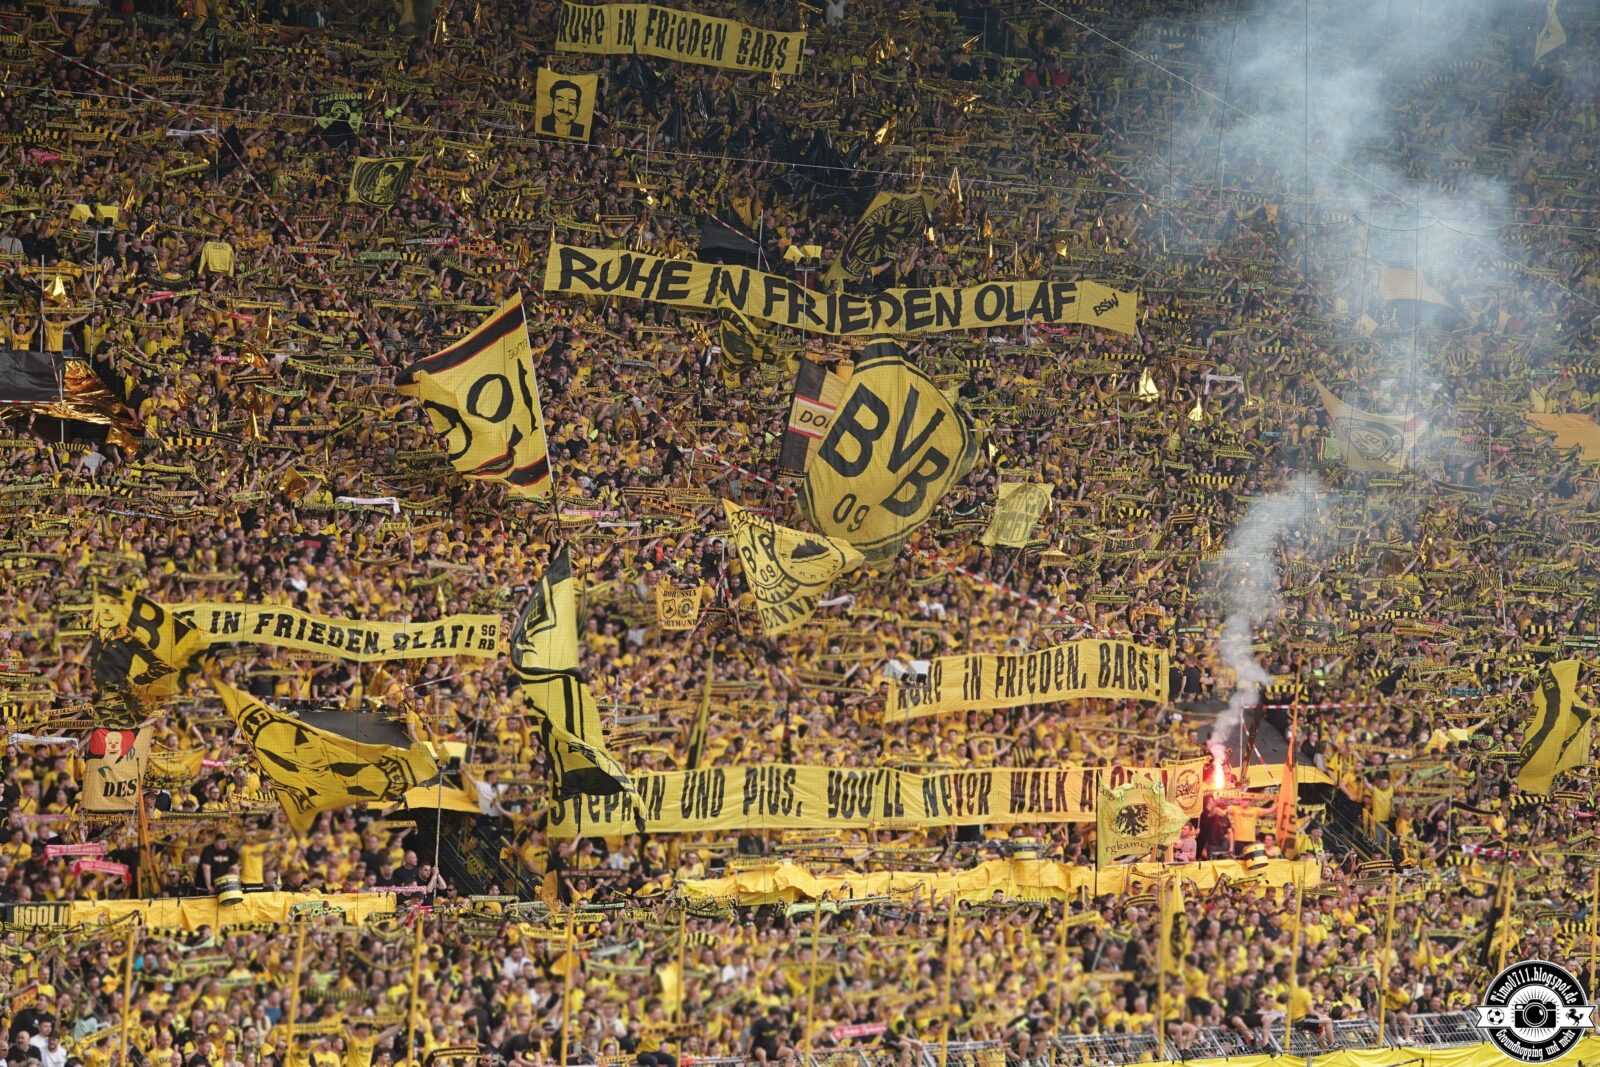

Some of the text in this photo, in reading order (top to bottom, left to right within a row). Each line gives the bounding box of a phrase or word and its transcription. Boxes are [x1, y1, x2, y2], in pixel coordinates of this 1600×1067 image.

[558, 247, 1078, 335] RUHE IN FRIEDEN OLAF
[799, 409, 831, 429] DO
[818, 382, 950, 518] BVB
[832, 493, 870, 533] 09
[759, 564, 776, 583] 09
[663, 589, 697, 598] BORUSSIA
[210, 610, 242, 634] IN
[253, 613, 386, 656] FRIEDEN,
[477, 639, 495, 650] RB
[481, 624, 497, 637] SG
[1098, 642, 1161, 696] BABS!
[102, 778, 138, 798] DES
[680, 768, 726, 819] UND
[1009, 770, 1069, 814] WALK
